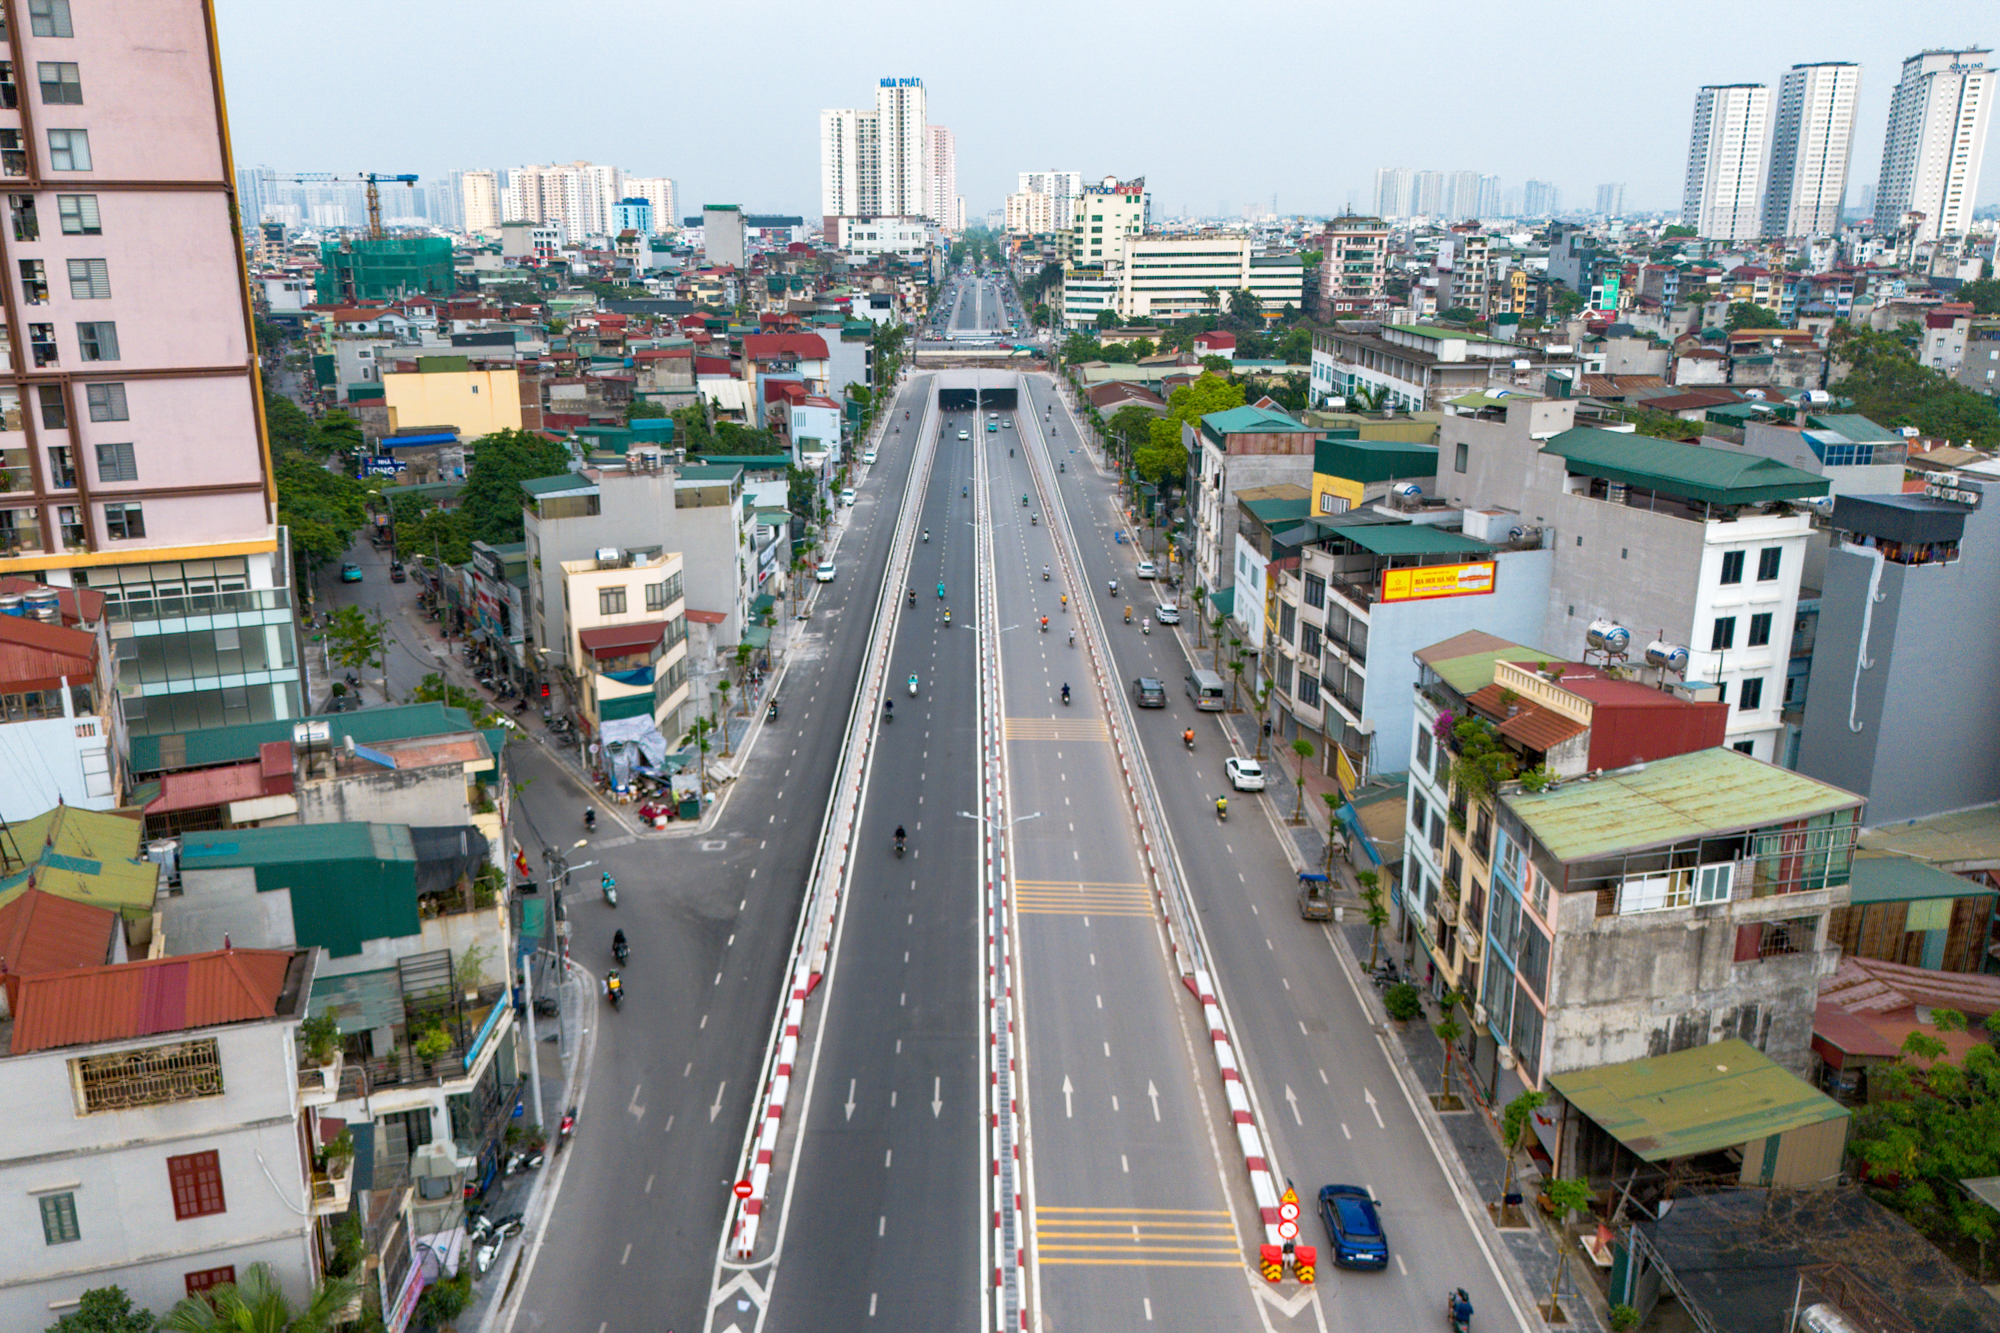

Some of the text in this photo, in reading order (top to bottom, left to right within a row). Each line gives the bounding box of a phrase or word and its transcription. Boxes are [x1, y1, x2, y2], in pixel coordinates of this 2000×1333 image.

[880, 76, 920, 87] HÒA PHÁT
[1085, 184, 1142, 195] mobifone
[1437, 575, 1445, 583] HÀ
[1446, 574, 1456, 583] NỘI
